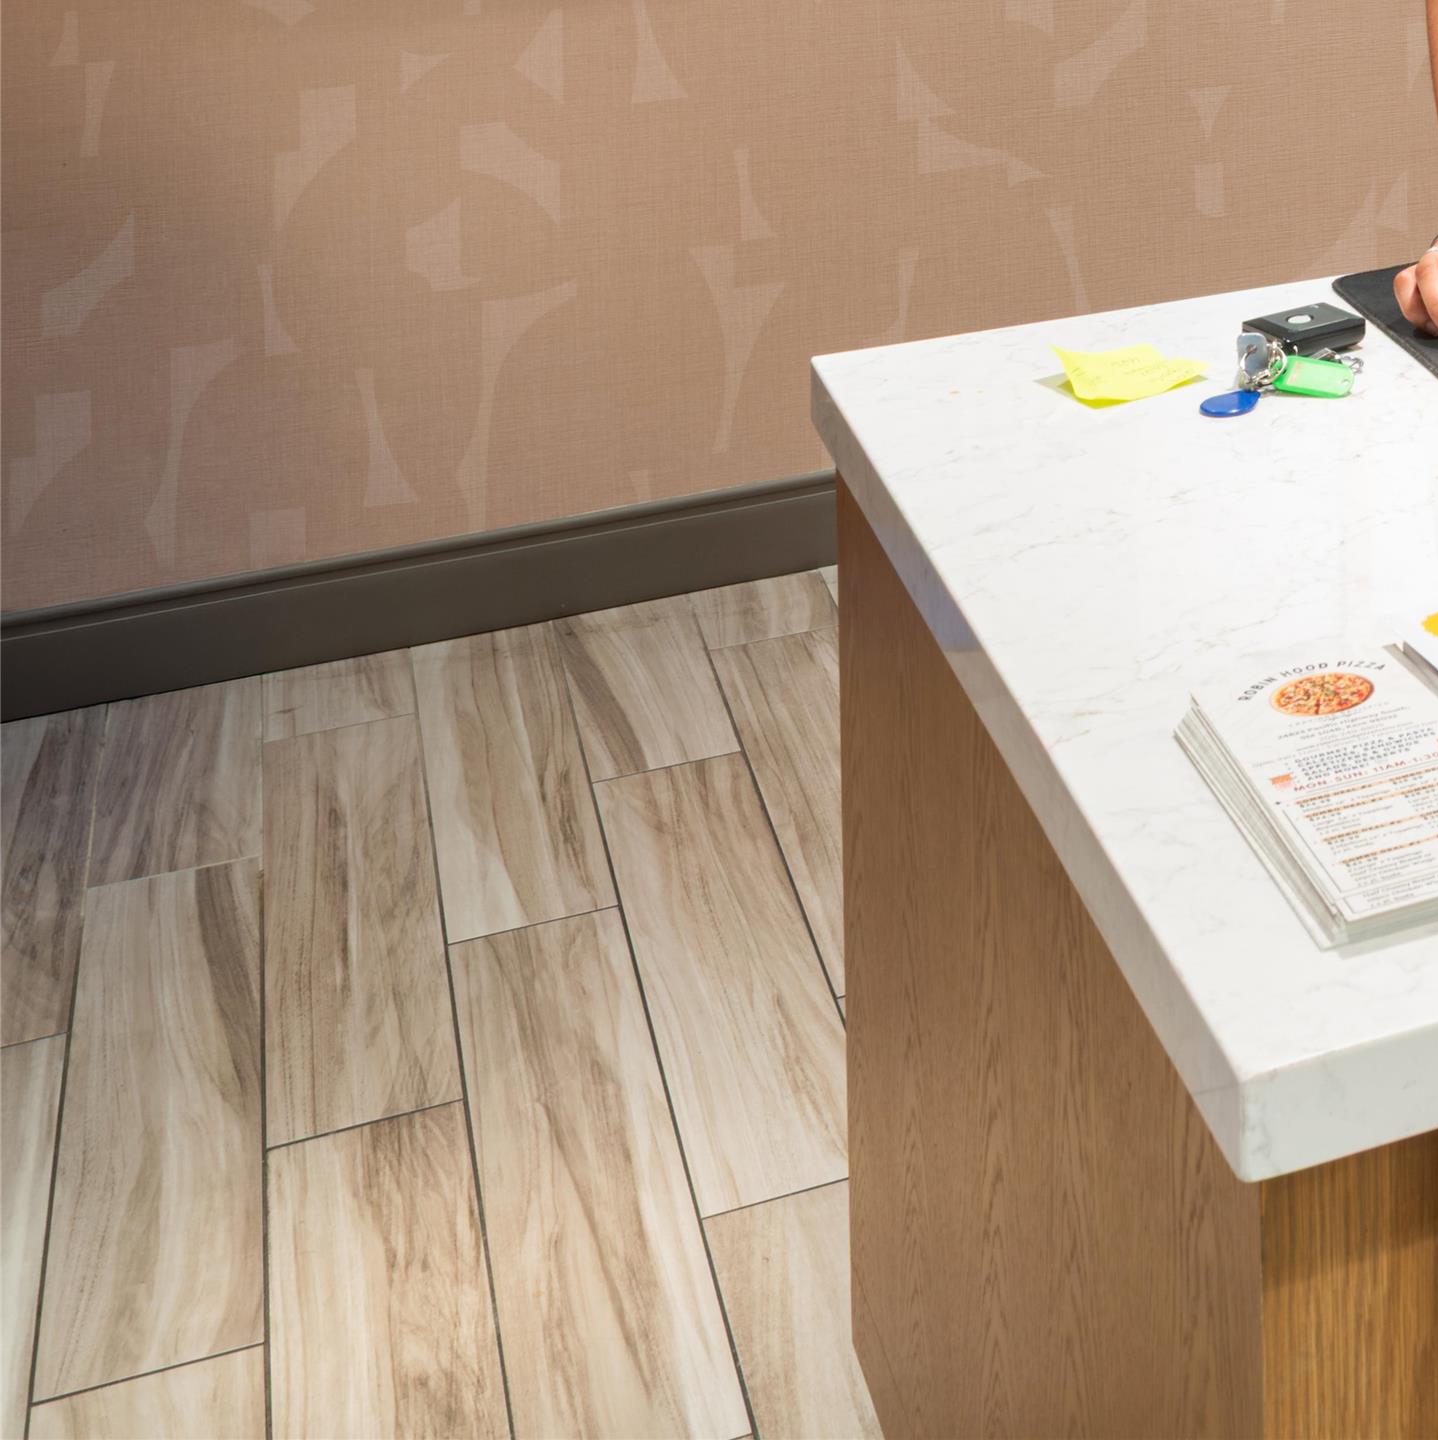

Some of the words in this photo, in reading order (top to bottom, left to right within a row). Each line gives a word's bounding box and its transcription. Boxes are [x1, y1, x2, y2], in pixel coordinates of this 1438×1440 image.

[1237, 675, 1278, 702] ROBIN
[1279, 661, 1330, 678] HOOD
[1335, 659, 1388, 672] PIZZA
[1294, 746, 1348, 764] GOURMET
[1353, 738, 1384, 750] PIZZA
